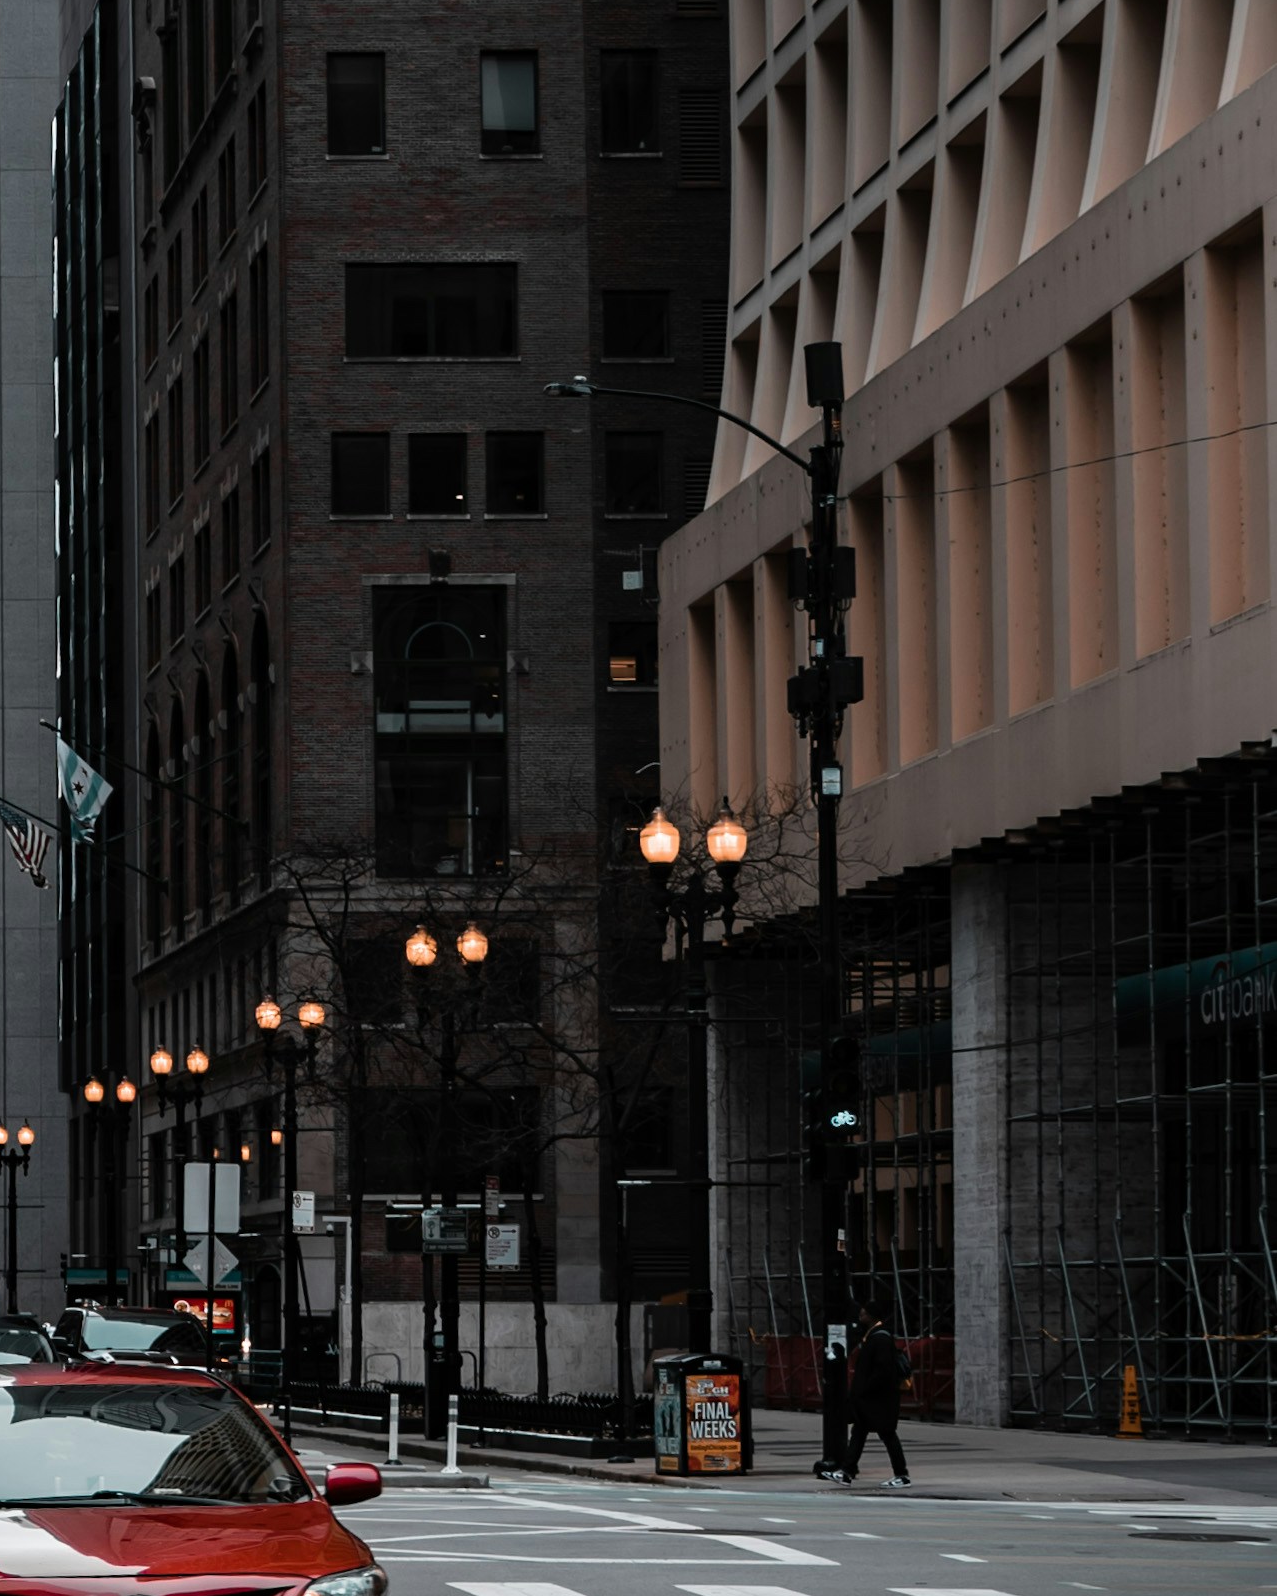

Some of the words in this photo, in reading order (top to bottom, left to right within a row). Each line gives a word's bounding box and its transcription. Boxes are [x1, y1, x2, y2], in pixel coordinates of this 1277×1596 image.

[1200, 966, 1277, 1025] citbank
[694, 1402, 734, 1420] FINAL
[690, 1420, 737, 1439] WEEKS
